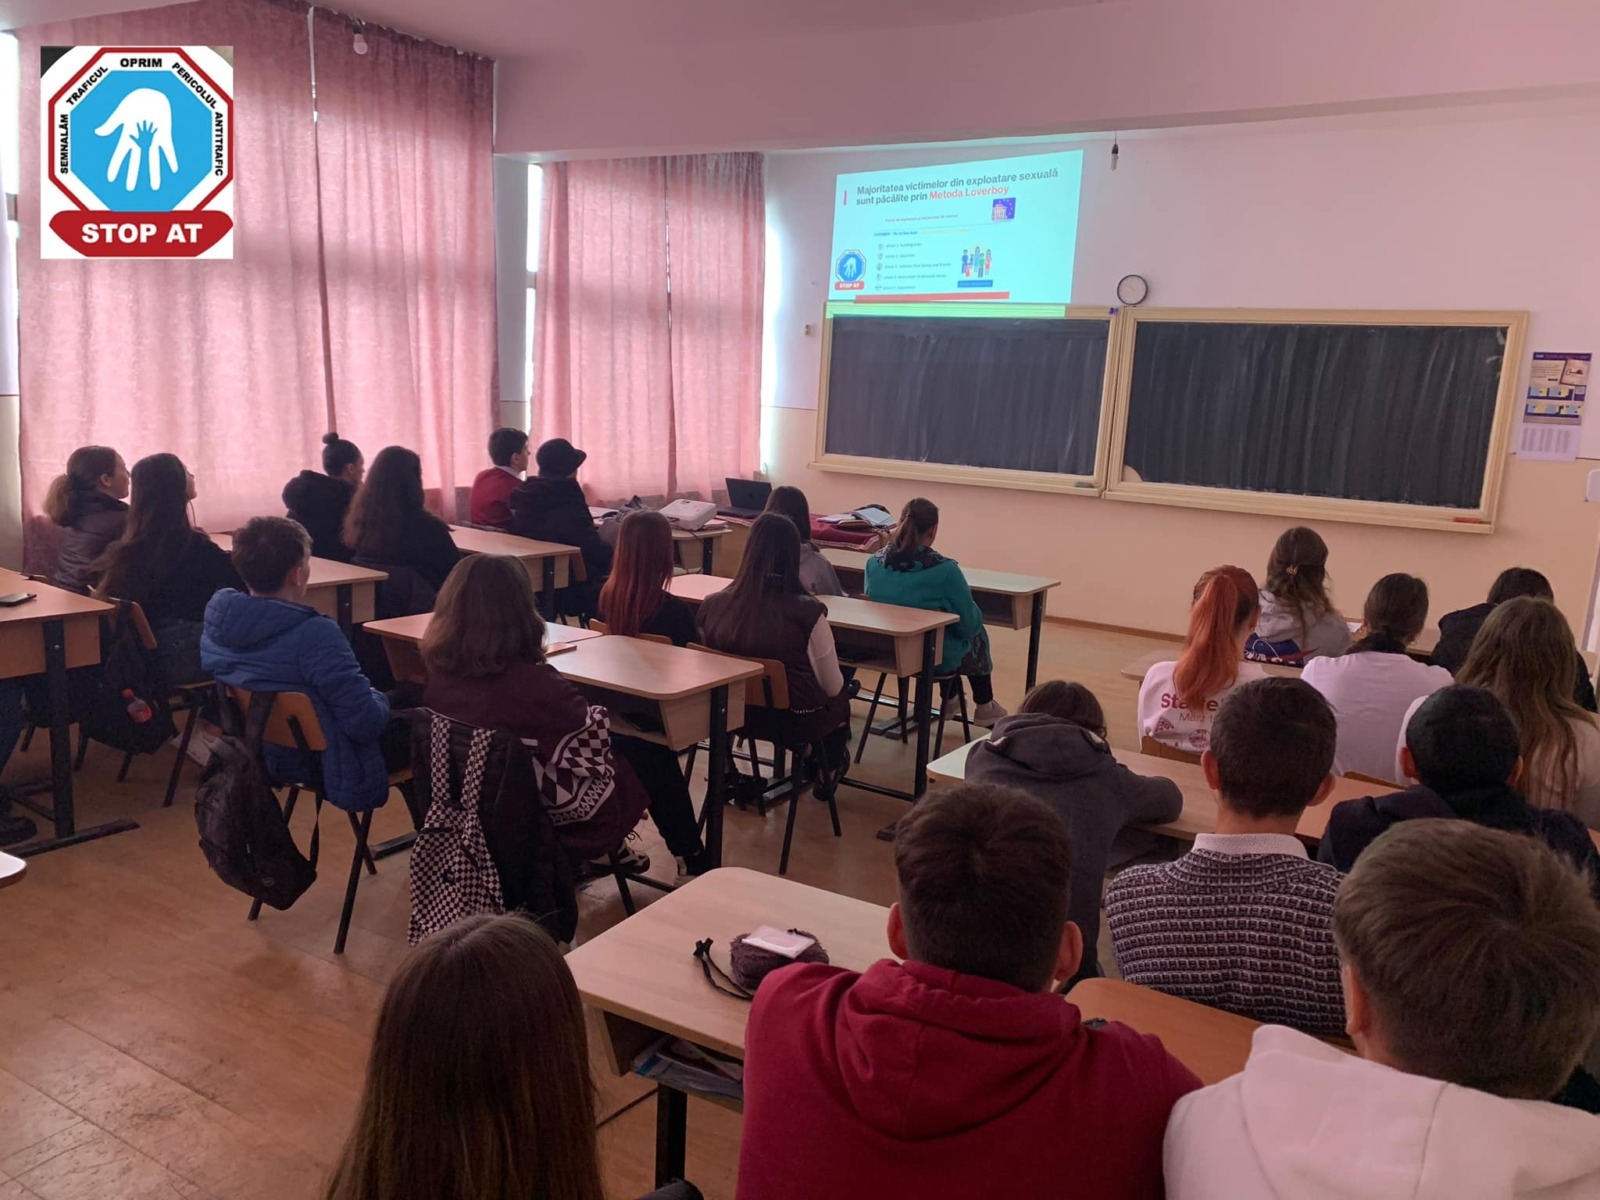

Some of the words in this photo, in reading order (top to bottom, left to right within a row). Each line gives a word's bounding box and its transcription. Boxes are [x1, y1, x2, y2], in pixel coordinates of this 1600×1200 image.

[857, 184, 904, 196] Majoritatea
[905, 180, 948, 192] victimelor
[950, 177, 964, 187] din
[966, 174, 1017, 187] exploatare
[1019, 167, 1058, 181] sexuală
[856, 196, 874, 205] sunt
[875, 193, 908, 206] păcălite
[910, 192, 928, 203] prin
[929, 189, 963, 200] Metoda
[965, 186, 1009, 197] Loverboy
